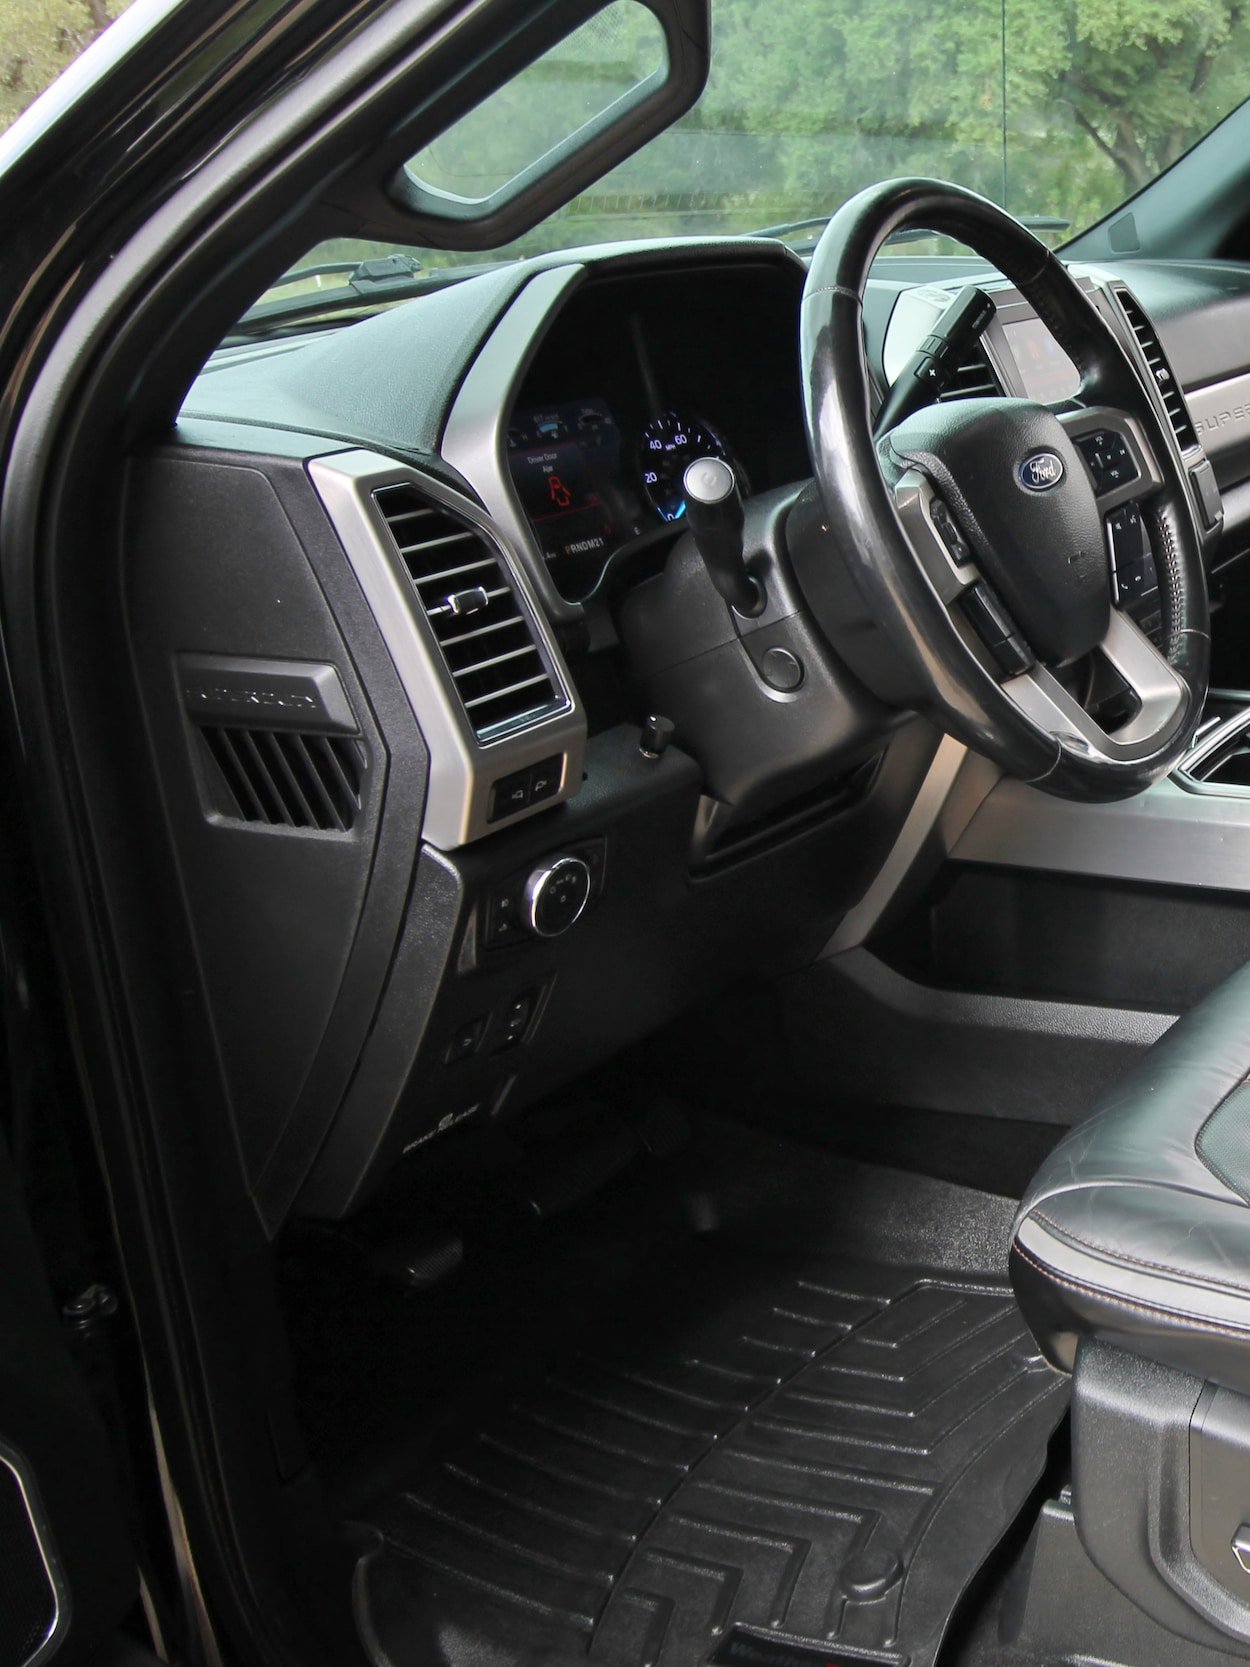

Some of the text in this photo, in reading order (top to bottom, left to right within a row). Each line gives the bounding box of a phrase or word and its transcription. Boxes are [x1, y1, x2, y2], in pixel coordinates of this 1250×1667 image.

[649, 439, 662, 450] 40
[674, 434, 688, 445] 60
[1029, 457, 1057, 484] Ford
[644, 472, 657, 484] 20
